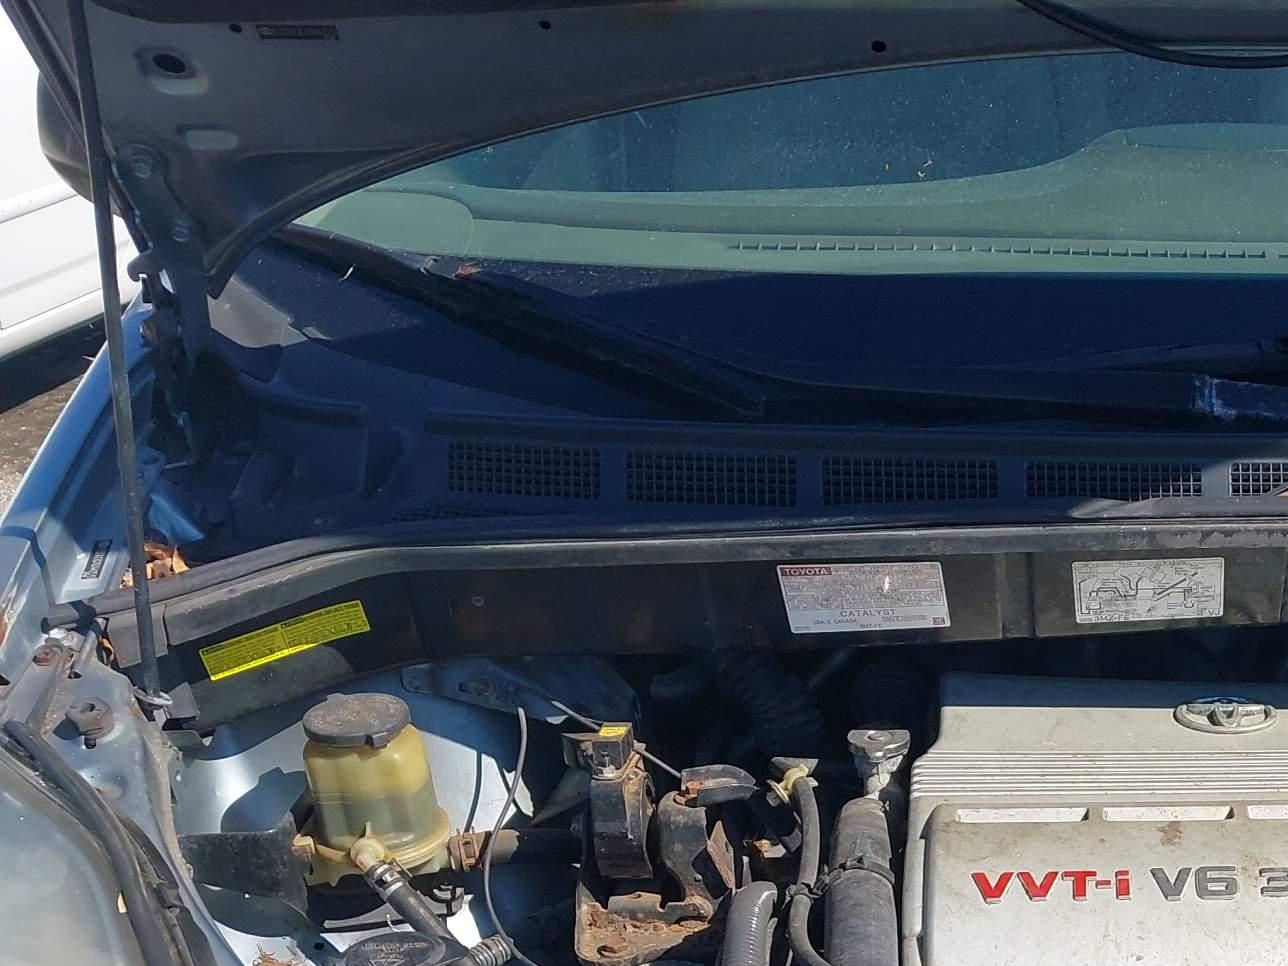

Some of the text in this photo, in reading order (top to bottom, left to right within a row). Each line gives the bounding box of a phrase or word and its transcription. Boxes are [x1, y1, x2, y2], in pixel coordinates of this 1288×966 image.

[784, 567, 829, 576] TOYOTA
[839, 608, 898, 618] CATALYST
[970, 868, 1132, 903] VVT-i
[1150, 865, 1240, 902] V6
